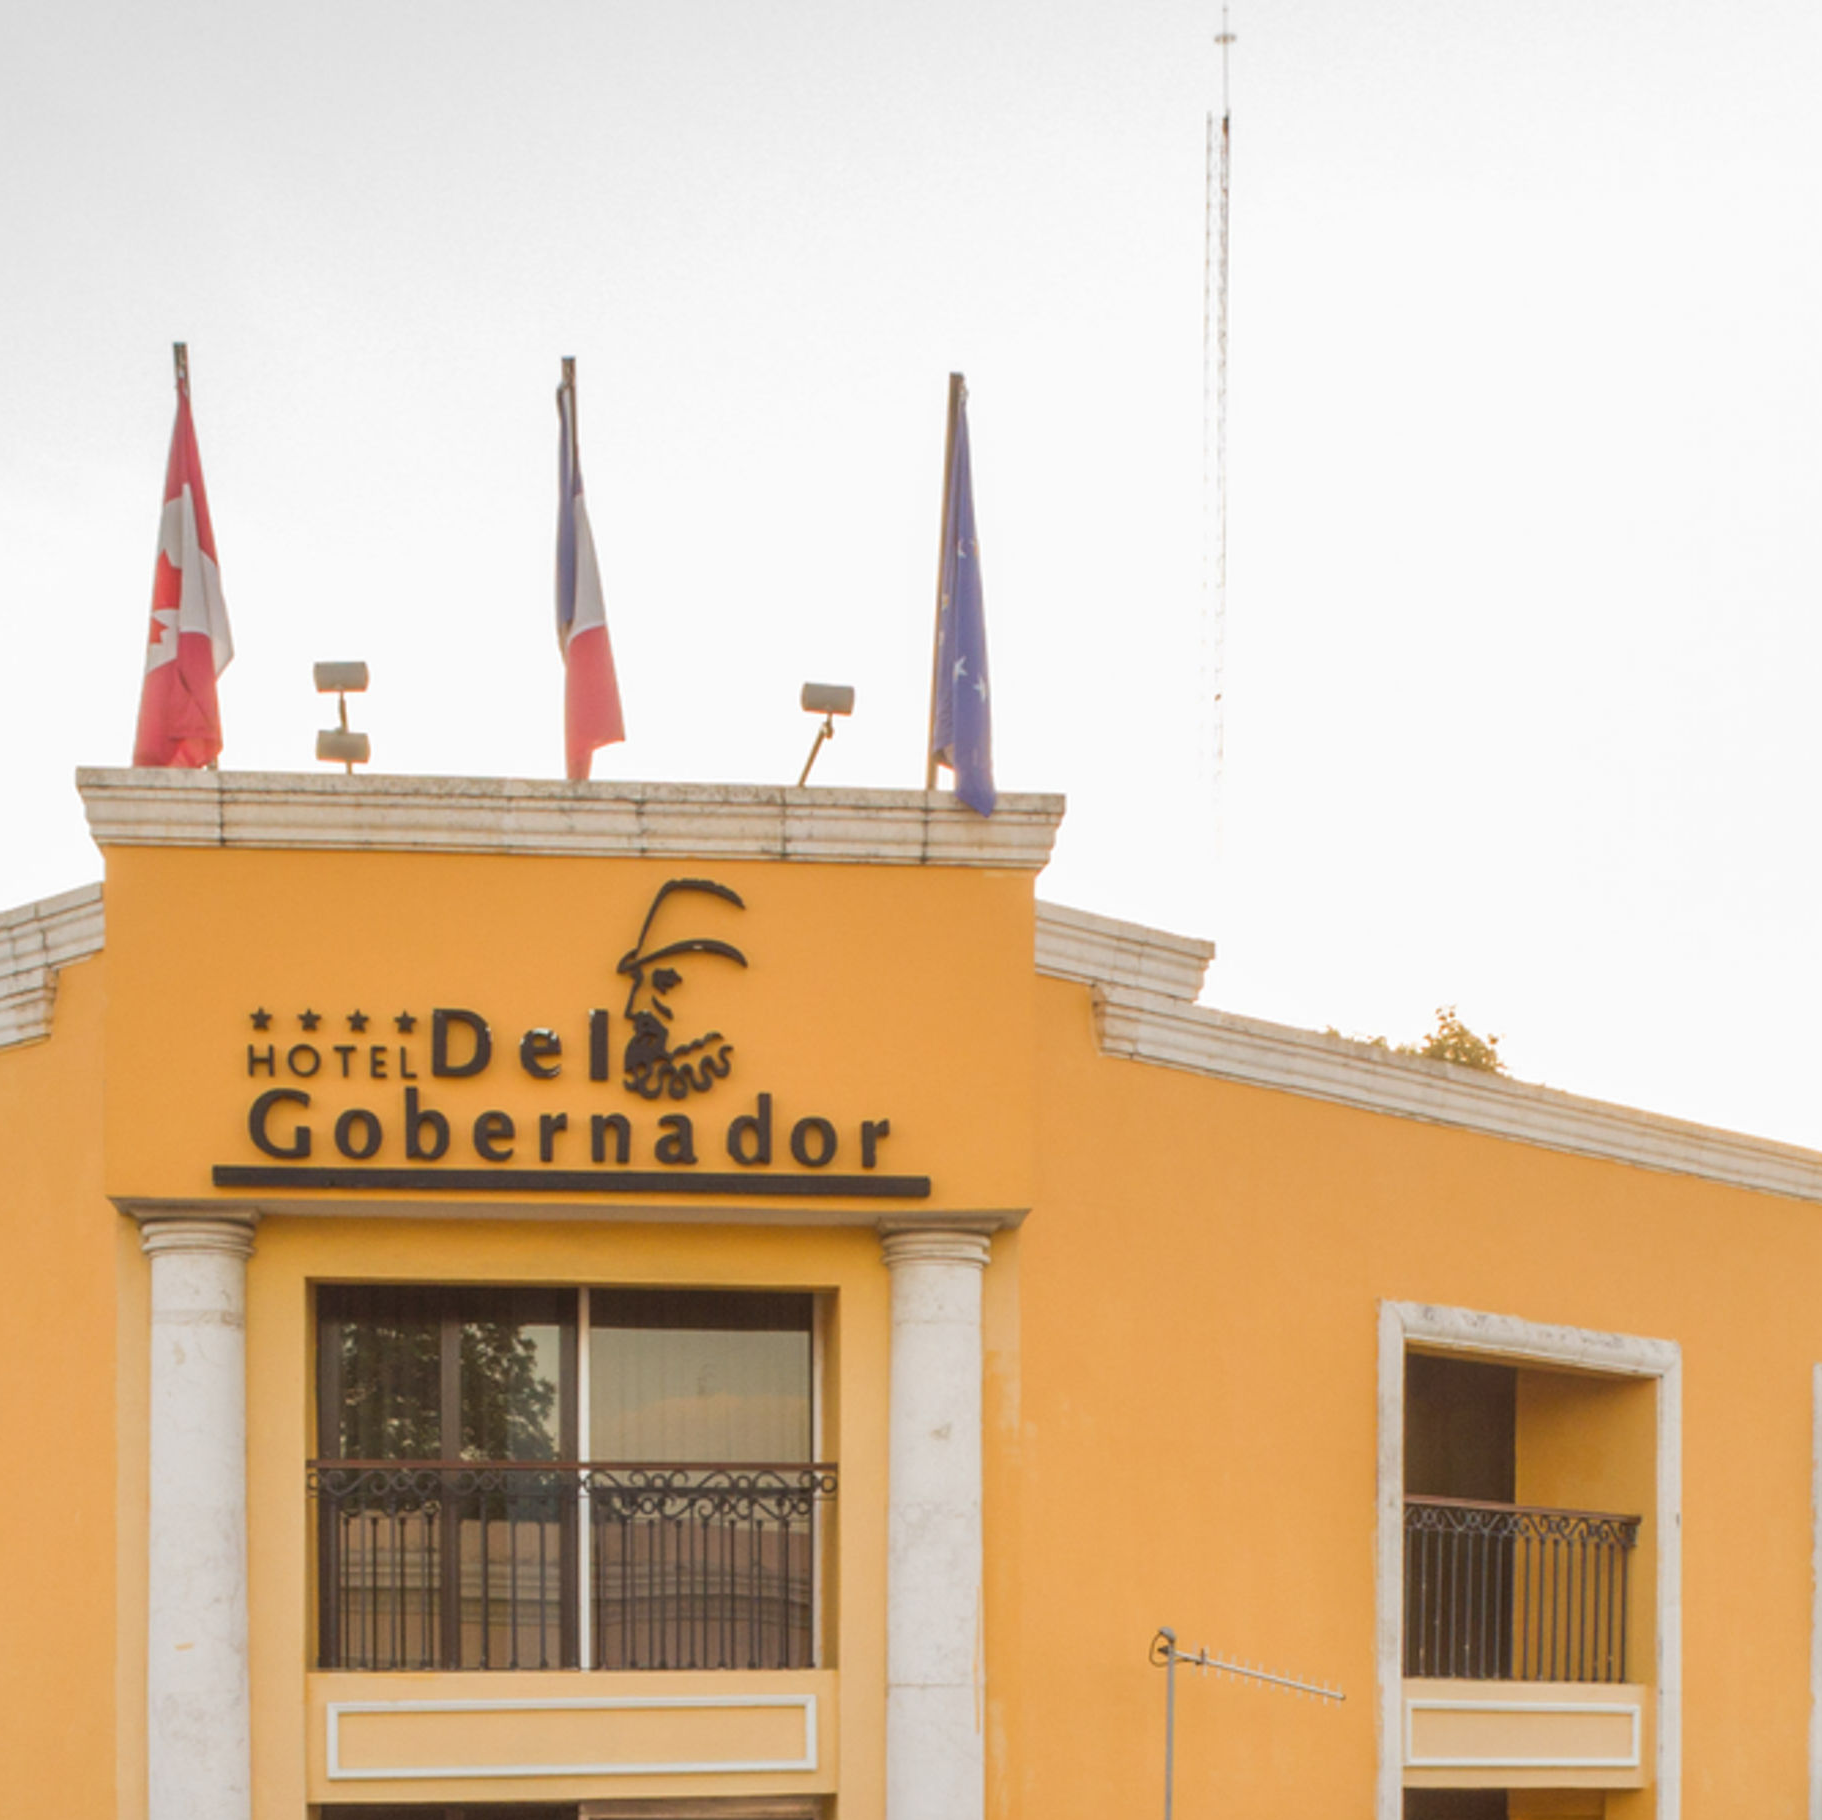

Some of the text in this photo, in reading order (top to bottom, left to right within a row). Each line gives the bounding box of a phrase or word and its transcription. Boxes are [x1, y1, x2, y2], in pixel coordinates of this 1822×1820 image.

[247, 1008, 610, 1082] HOTEL Del
[248, 1087, 890, 1168] Gobernador
